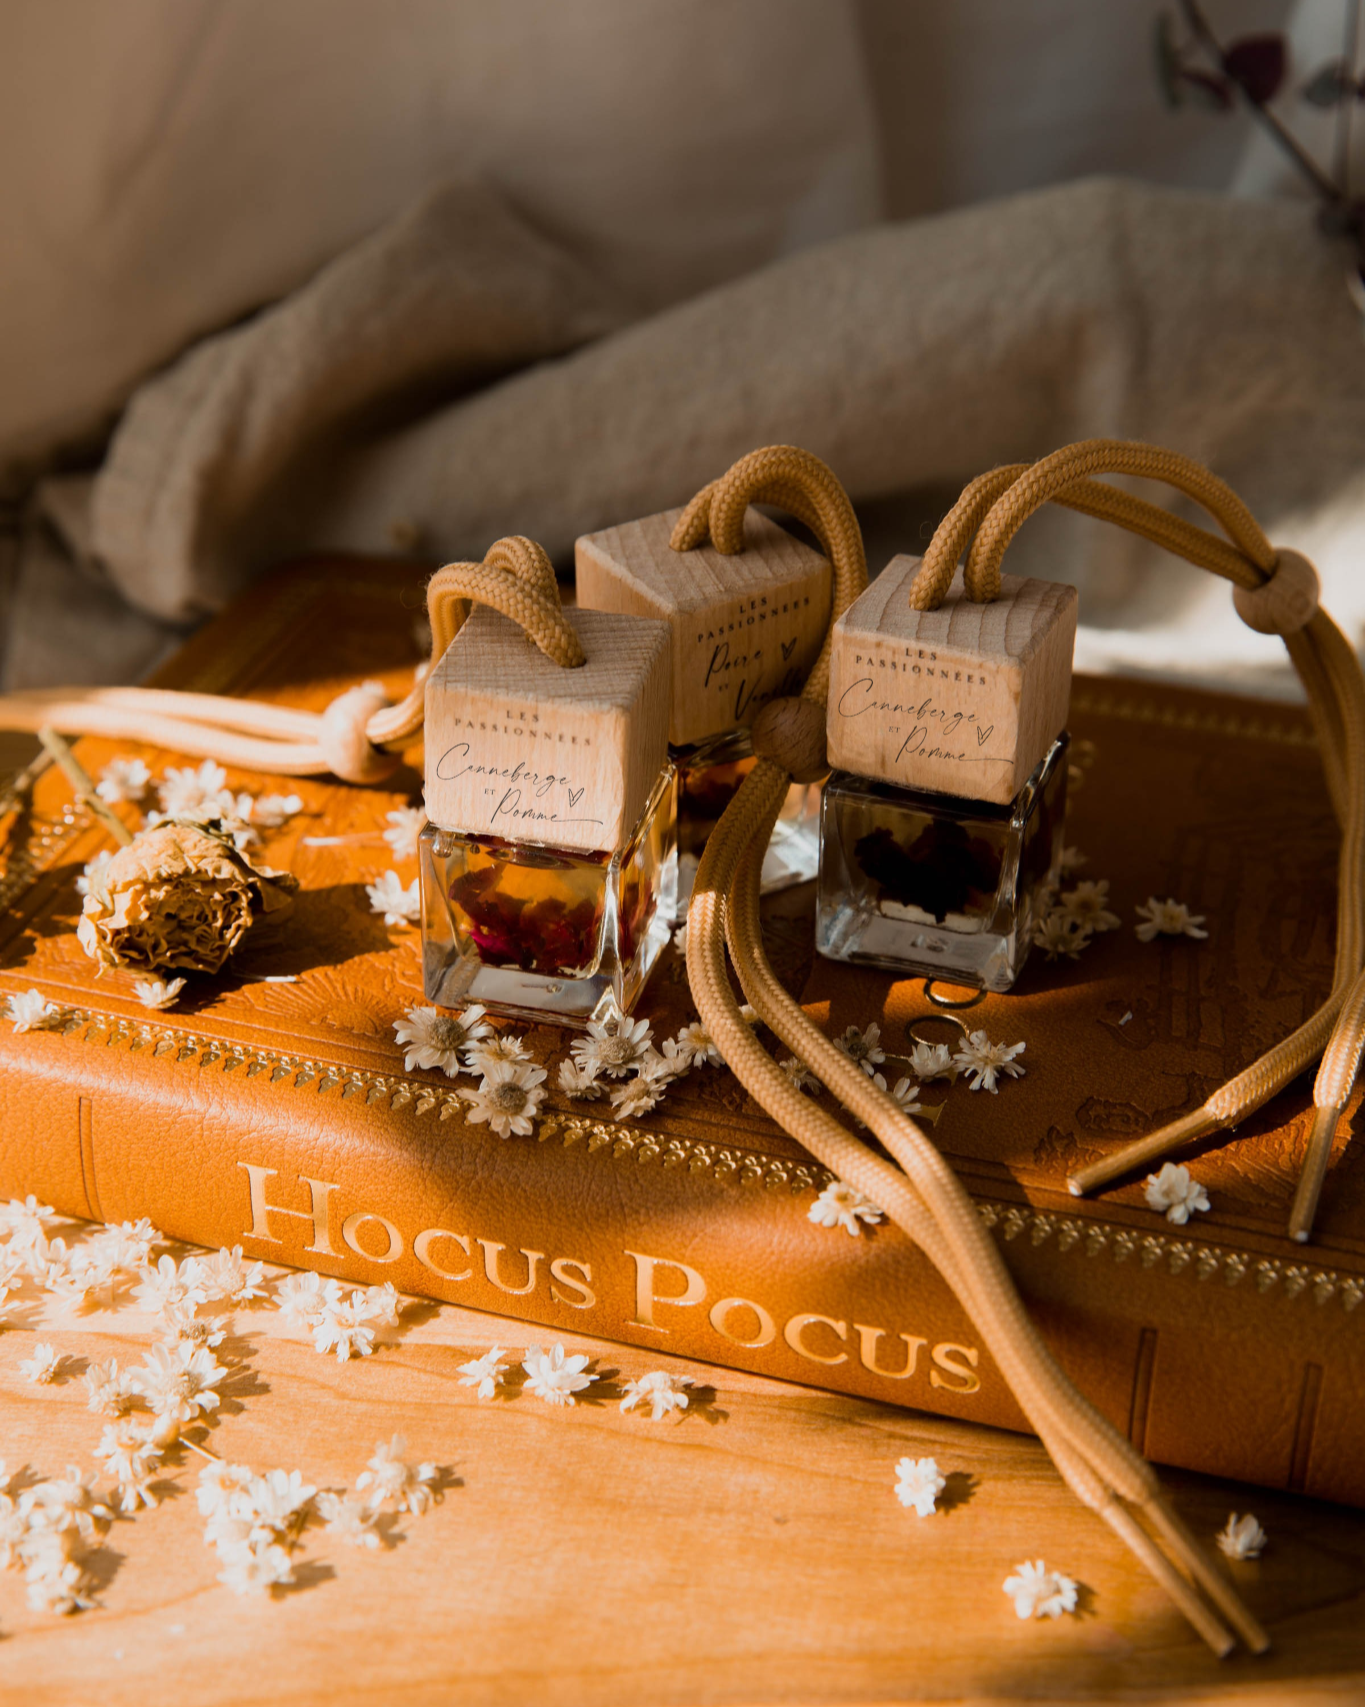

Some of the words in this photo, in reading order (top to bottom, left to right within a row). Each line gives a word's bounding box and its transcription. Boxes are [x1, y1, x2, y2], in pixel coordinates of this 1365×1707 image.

[739, 597, 768, 614] LES
[704, 641, 762, 688] Poire
[905, 647, 938, 661] LES
[506, 709, 540, 723] LES
[838, 677, 980, 735] Canneberge
[895, 725, 1014, 764] Pomme
[436, 742, 571, 798] Canneberge
[484, 788, 496, 796] ET
[490, 787, 604, 825] Pomme
